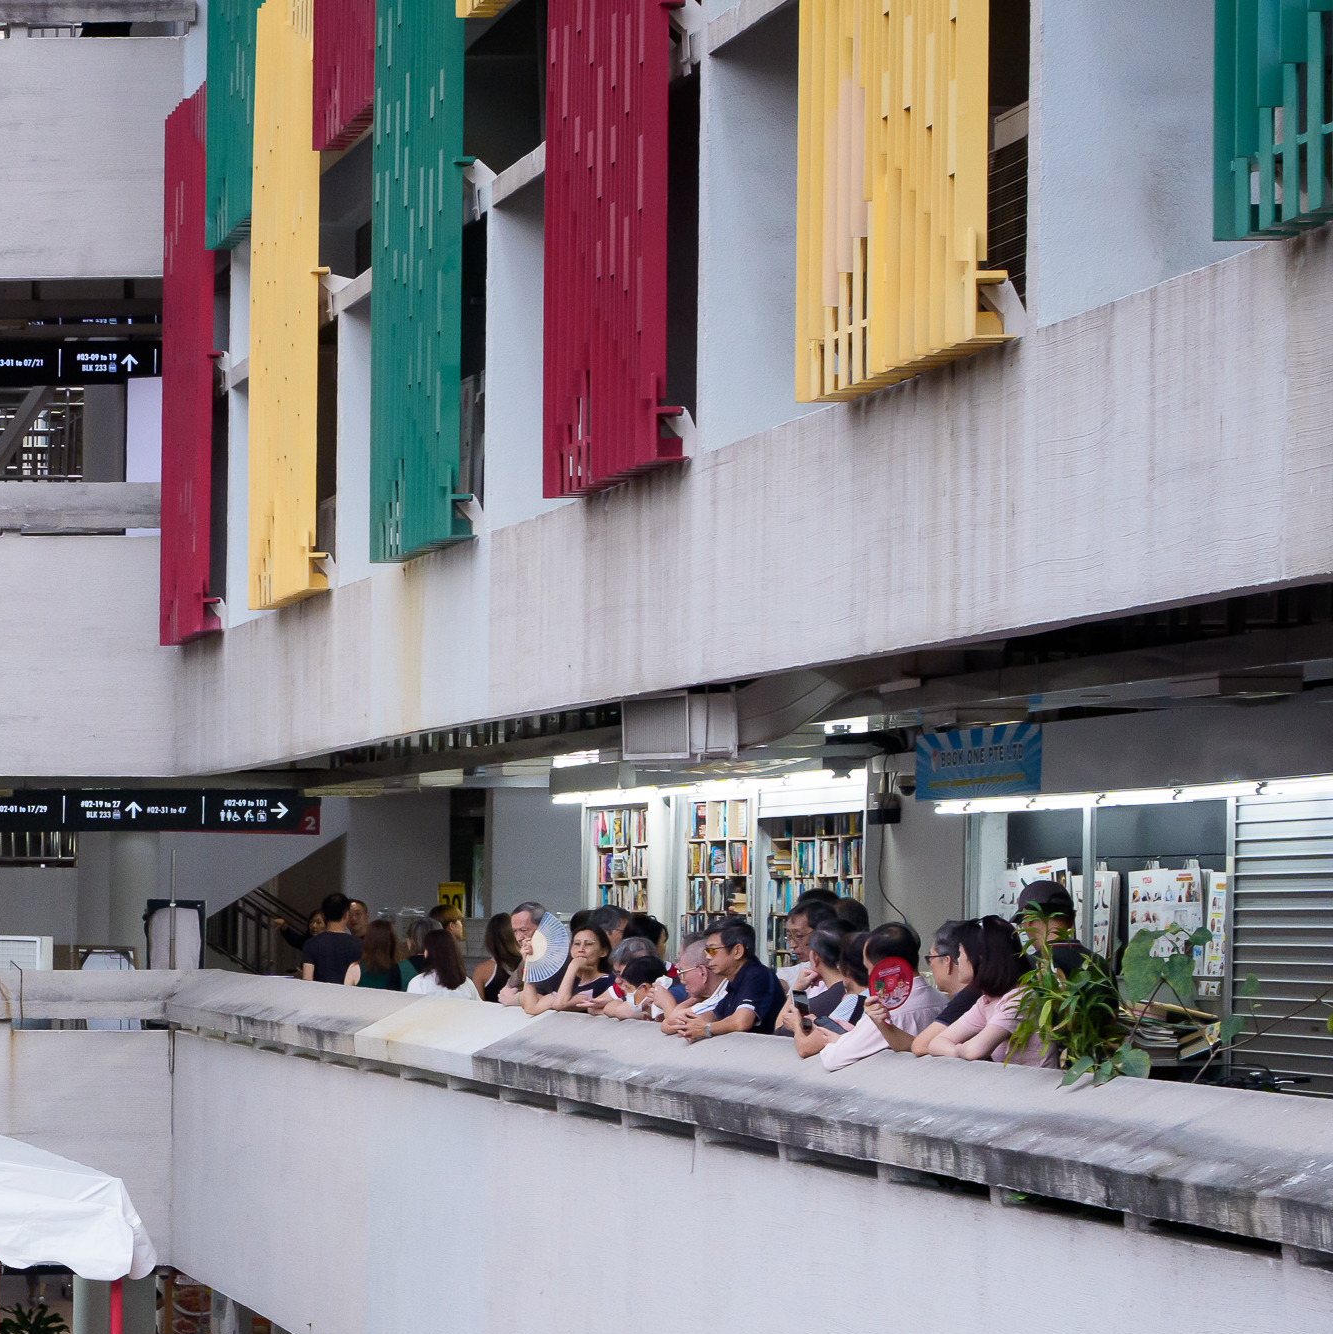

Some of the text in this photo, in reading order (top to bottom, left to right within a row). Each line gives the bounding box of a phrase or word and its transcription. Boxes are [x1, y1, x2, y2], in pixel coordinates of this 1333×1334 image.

[109, 353, 117, 361] 19
[82, 364, 107, 372] BLK 233
[941, 748, 964, 768] BOOK
[967, 746, 985, 765] ONE
[988, 744, 1004, 763] PTE
[86, 811, 111, 819] BLK 233
[304, 816, 316, 831] 2
